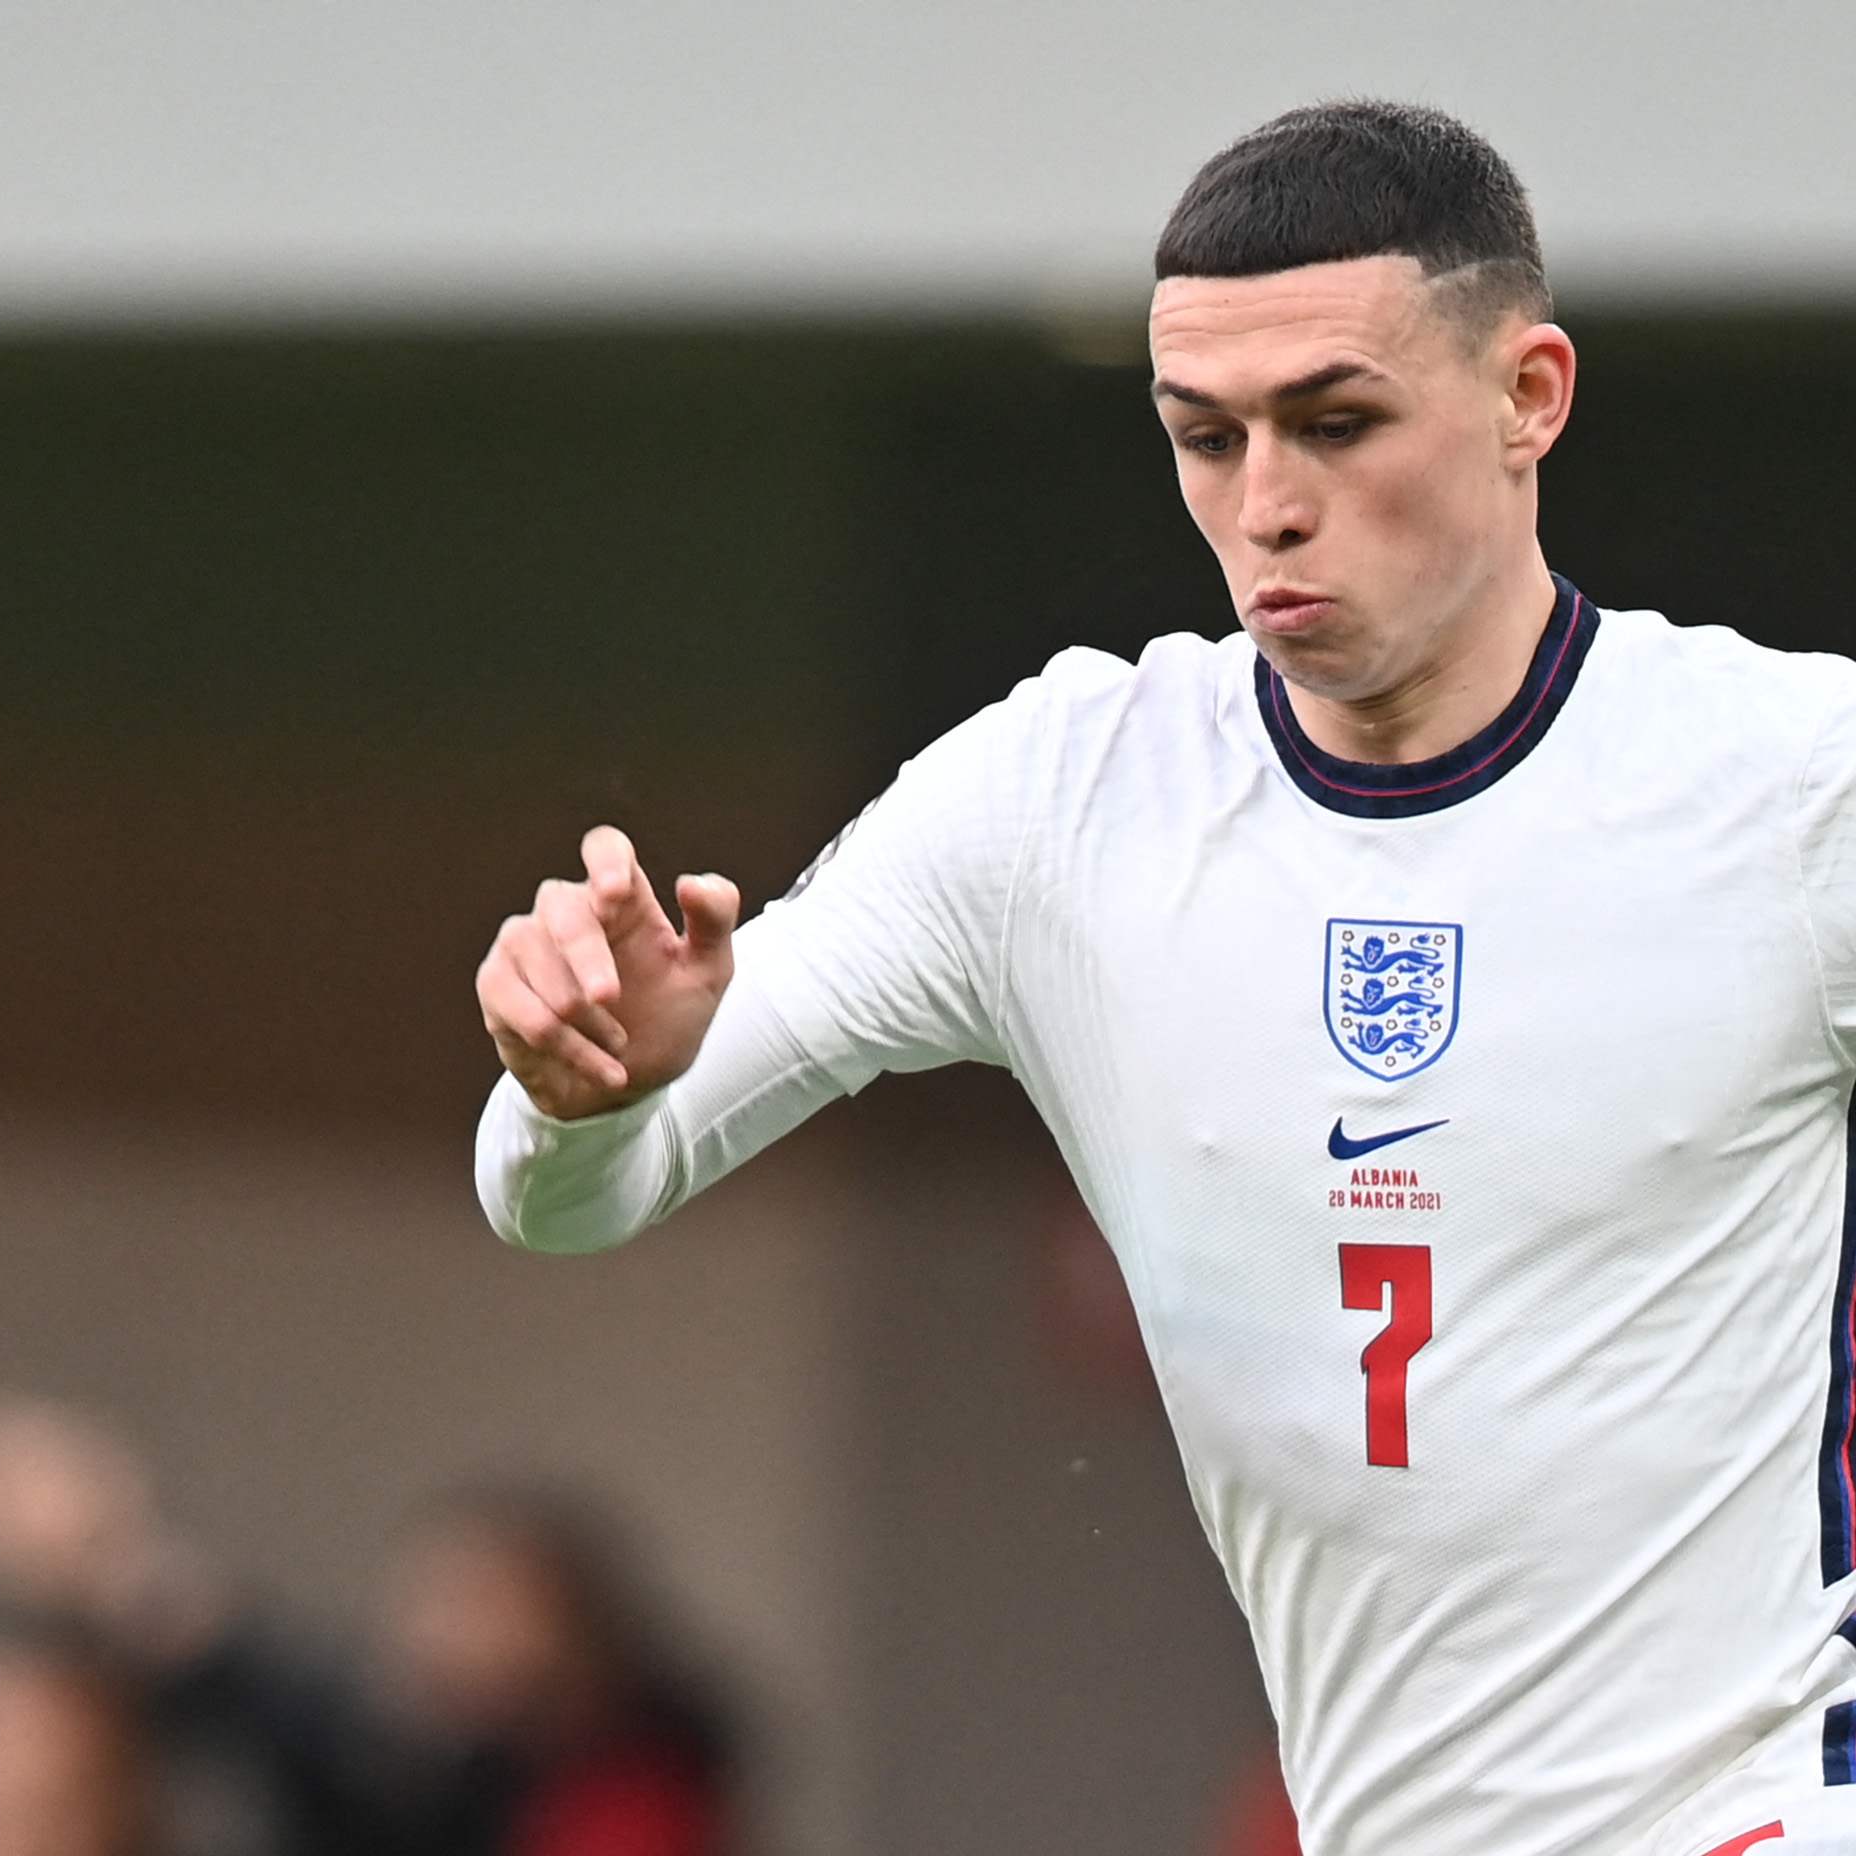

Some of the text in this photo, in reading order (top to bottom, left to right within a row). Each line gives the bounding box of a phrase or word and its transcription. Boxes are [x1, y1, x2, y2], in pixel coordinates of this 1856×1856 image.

[1350, 1168, 1419, 1188] ALBANIA
[1328, 1189, 1442, 1211] 28 MARCH 2021
[1338, 1242, 1433, 1468] 7
